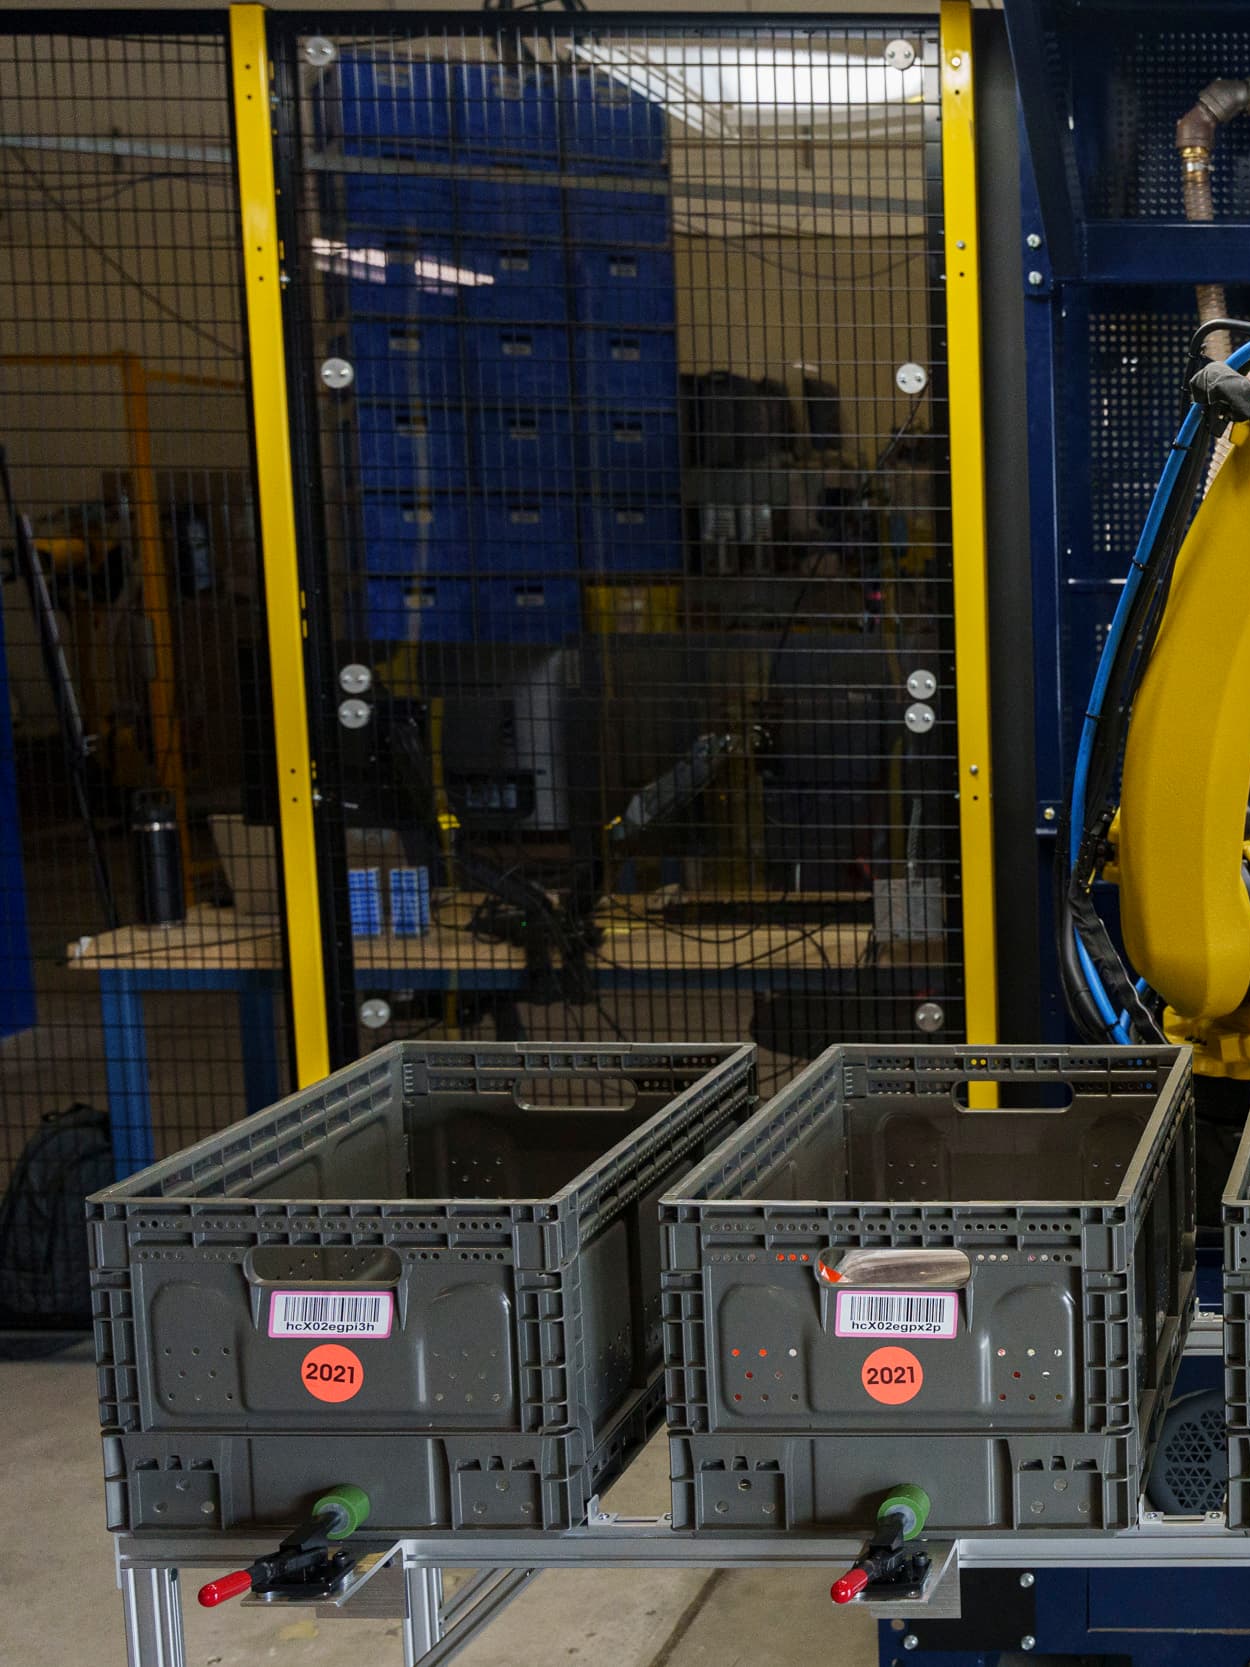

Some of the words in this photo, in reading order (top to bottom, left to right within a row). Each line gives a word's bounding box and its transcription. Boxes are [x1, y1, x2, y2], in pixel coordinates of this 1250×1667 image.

[286, 1321, 375, 1333] hcX02egpi3h
[851, 1321, 941, 1334] hcX02egpx2p
[305, 1362, 355, 1384] 2021
[866, 1366, 915, 1385] 2021
